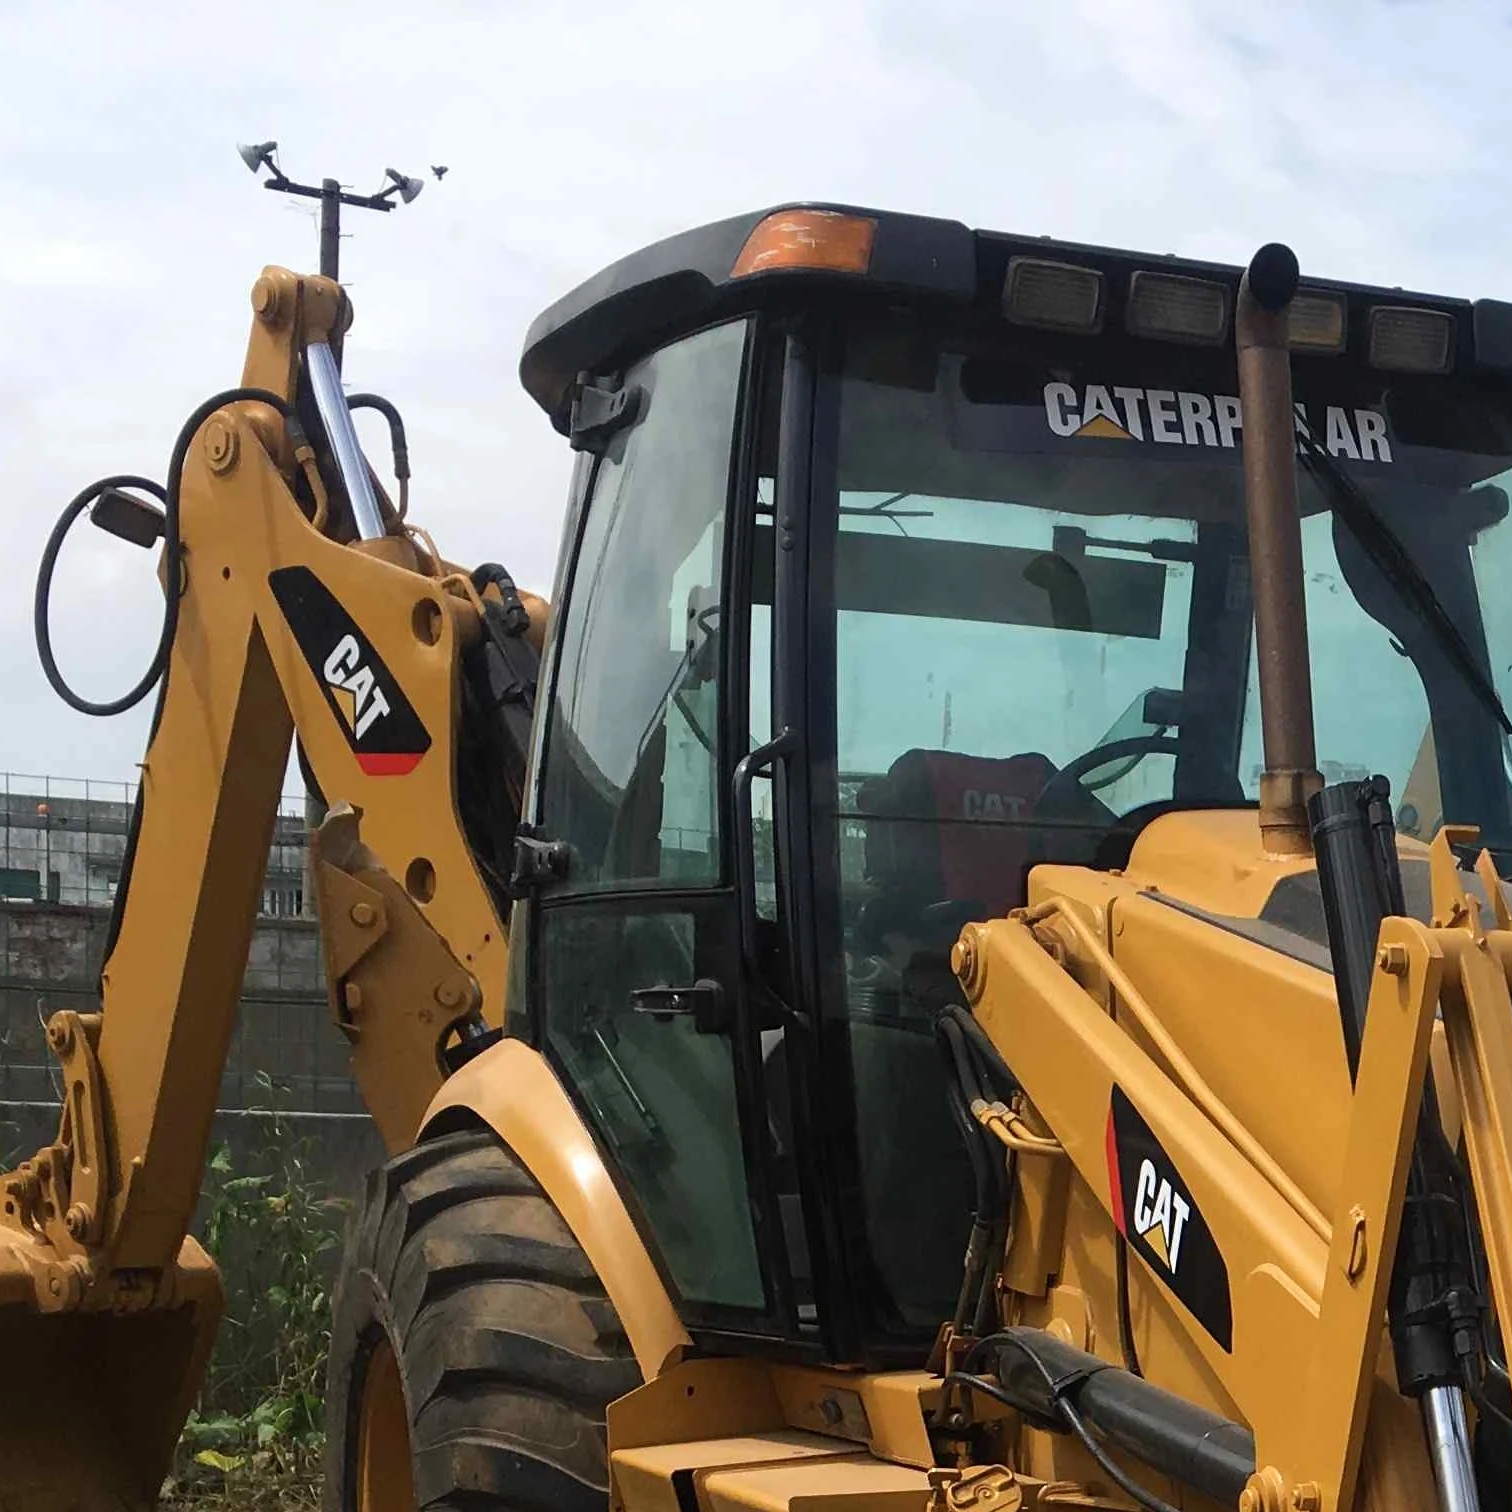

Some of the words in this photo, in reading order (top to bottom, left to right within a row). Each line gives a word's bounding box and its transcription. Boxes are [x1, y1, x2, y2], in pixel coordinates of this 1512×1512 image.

[323, 634, 390, 740] CAT
[963, 789, 1026, 821] CAT
[1134, 1158, 1190, 1274] CAT
